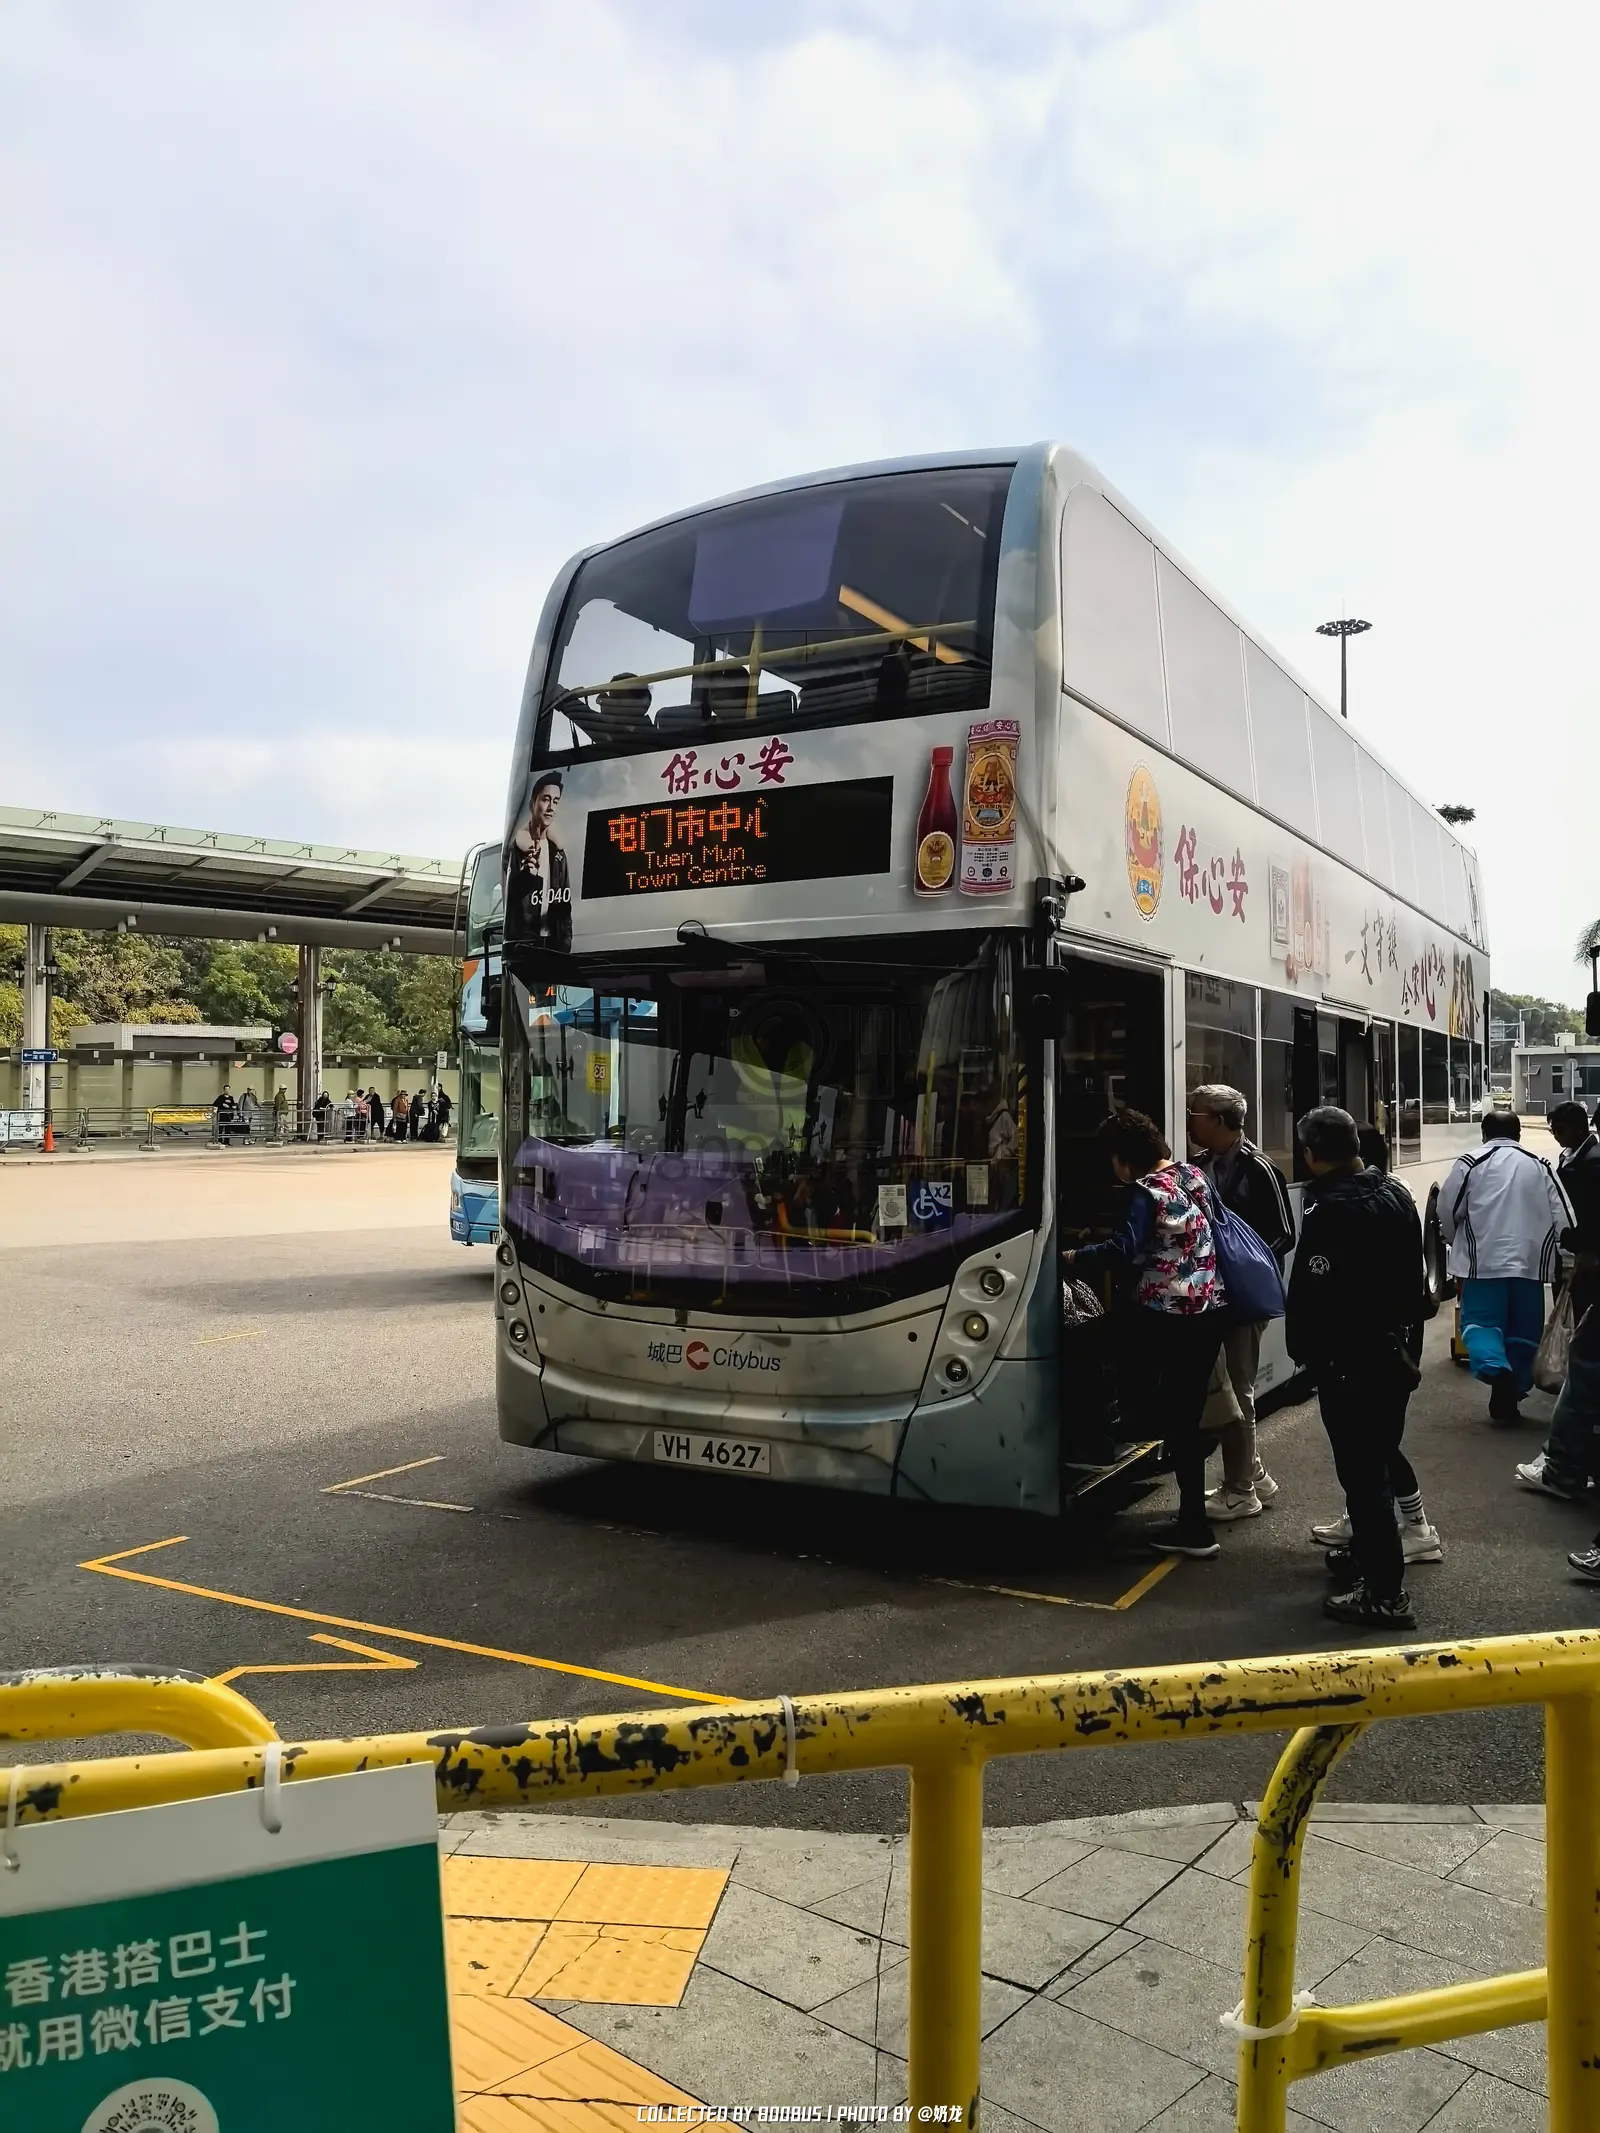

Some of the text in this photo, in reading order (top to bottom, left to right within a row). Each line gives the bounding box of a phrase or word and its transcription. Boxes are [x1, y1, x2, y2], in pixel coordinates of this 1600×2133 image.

[660, 737, 795, 795] 保心安
[644, 844, 745, 869] Tuen Mun
[625, 862, 767, 890] Town Centre
[1173, 824, 1249, 924] 保心安
[530, 887, 571, 906] 63040
[647, 1341, 683, 1364] 城巴
[713, 1347, 781, 1372] Citybus
[661, 1434, 762, 1469] VH 4627
[4, 1920, 269, 2007] 香港搭巴士
[0, 1972, 298, 2072] 就用微信支付
